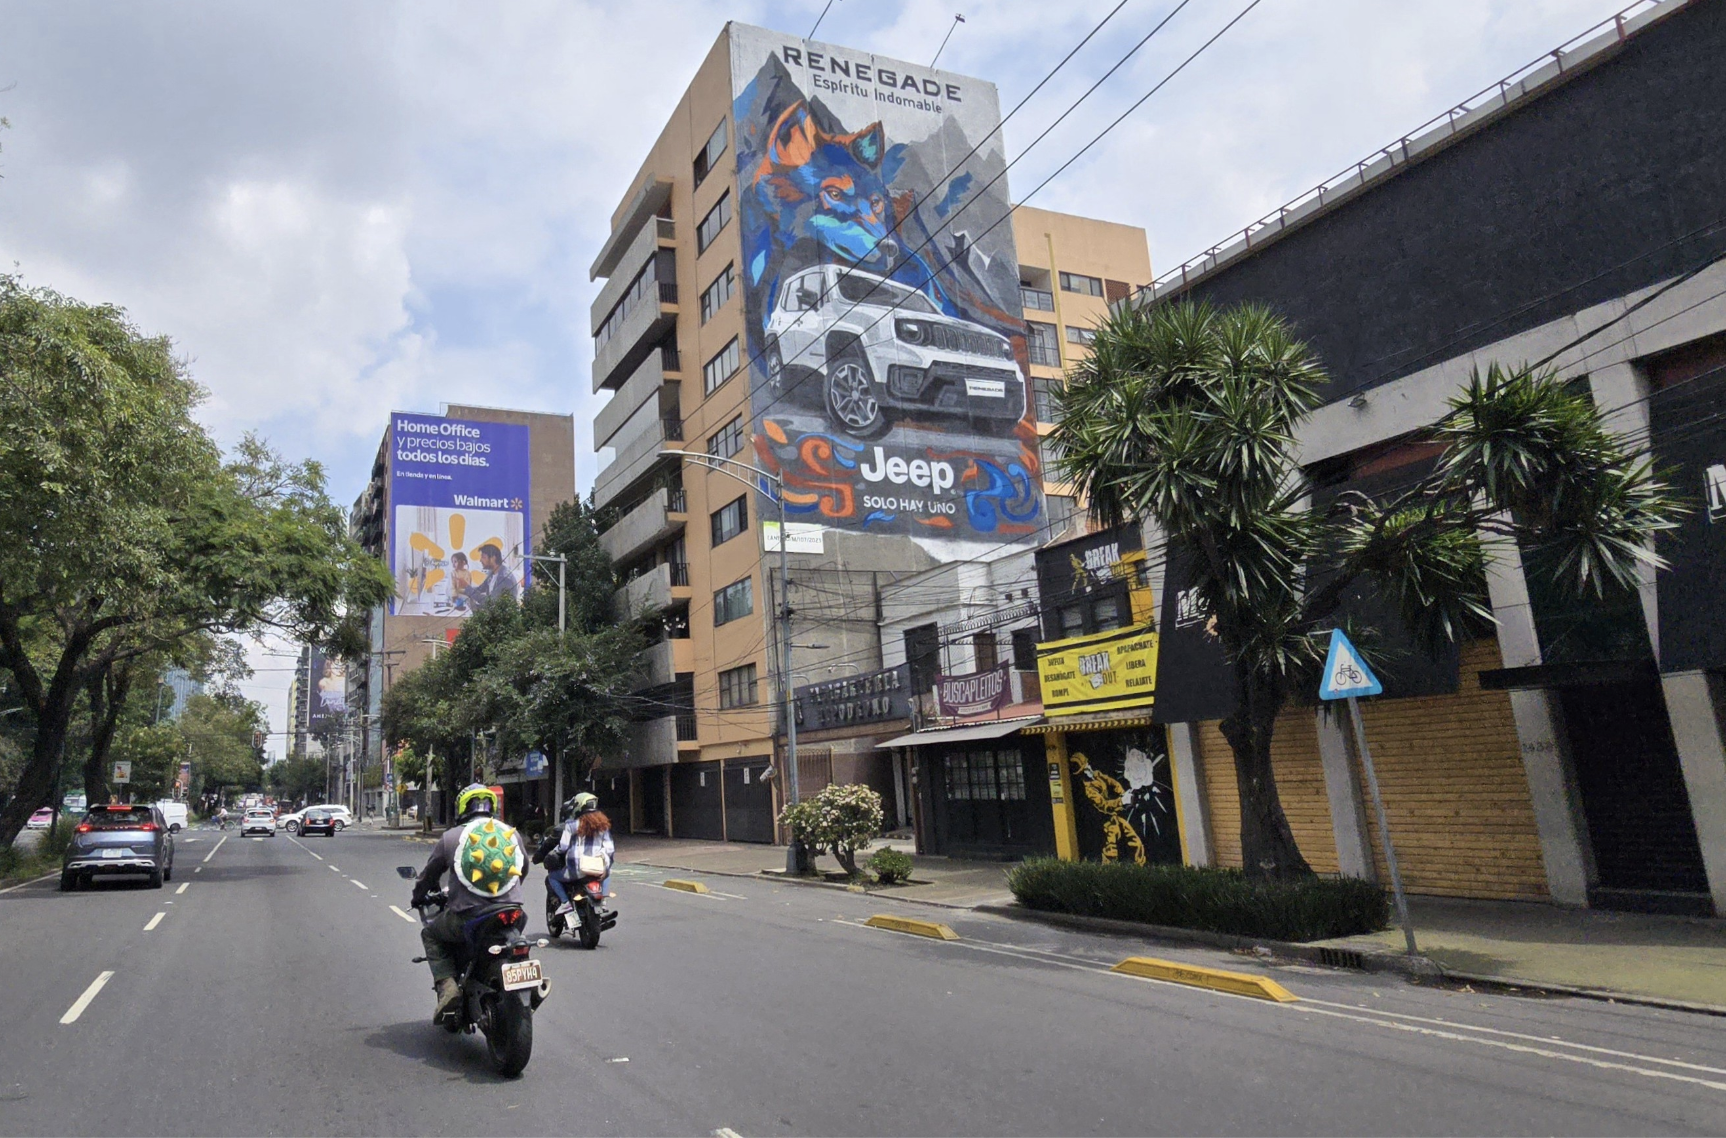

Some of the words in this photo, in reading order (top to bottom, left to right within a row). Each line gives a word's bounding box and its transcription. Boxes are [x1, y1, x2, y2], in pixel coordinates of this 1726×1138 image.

[783, 45, 962, 102] RENEGADE
[813, 74, 868, 97] Espíritu
[874, 88, 942, 113] Indomable
[397, 420, 438, 434] Home
[440, 423, 480, 438] Office
[397, 436, 406, 448] y
[407, 436, 455, 450] precios
[456, 438, 491, 454] bajos
[397, 449, 436, 463] todos
[438, 451, 458, 464] los
[459, 453, 490, 467] días.
[860, 446, 954, 495] Jeep
[454, 494, 509, 508] Walmart
[863, 495, 897, 510] SOLO
[900, 499, 923, 512] HAY
[928, 501, 955, 514] UNO
[1085, 542, 1120, 570] BREAK
[1078, 651, 1110, 676] BREAK
[943, 669, 1003, 703] BUSCAPLEITOS
[1102, 671, 1117, 685] OUT
